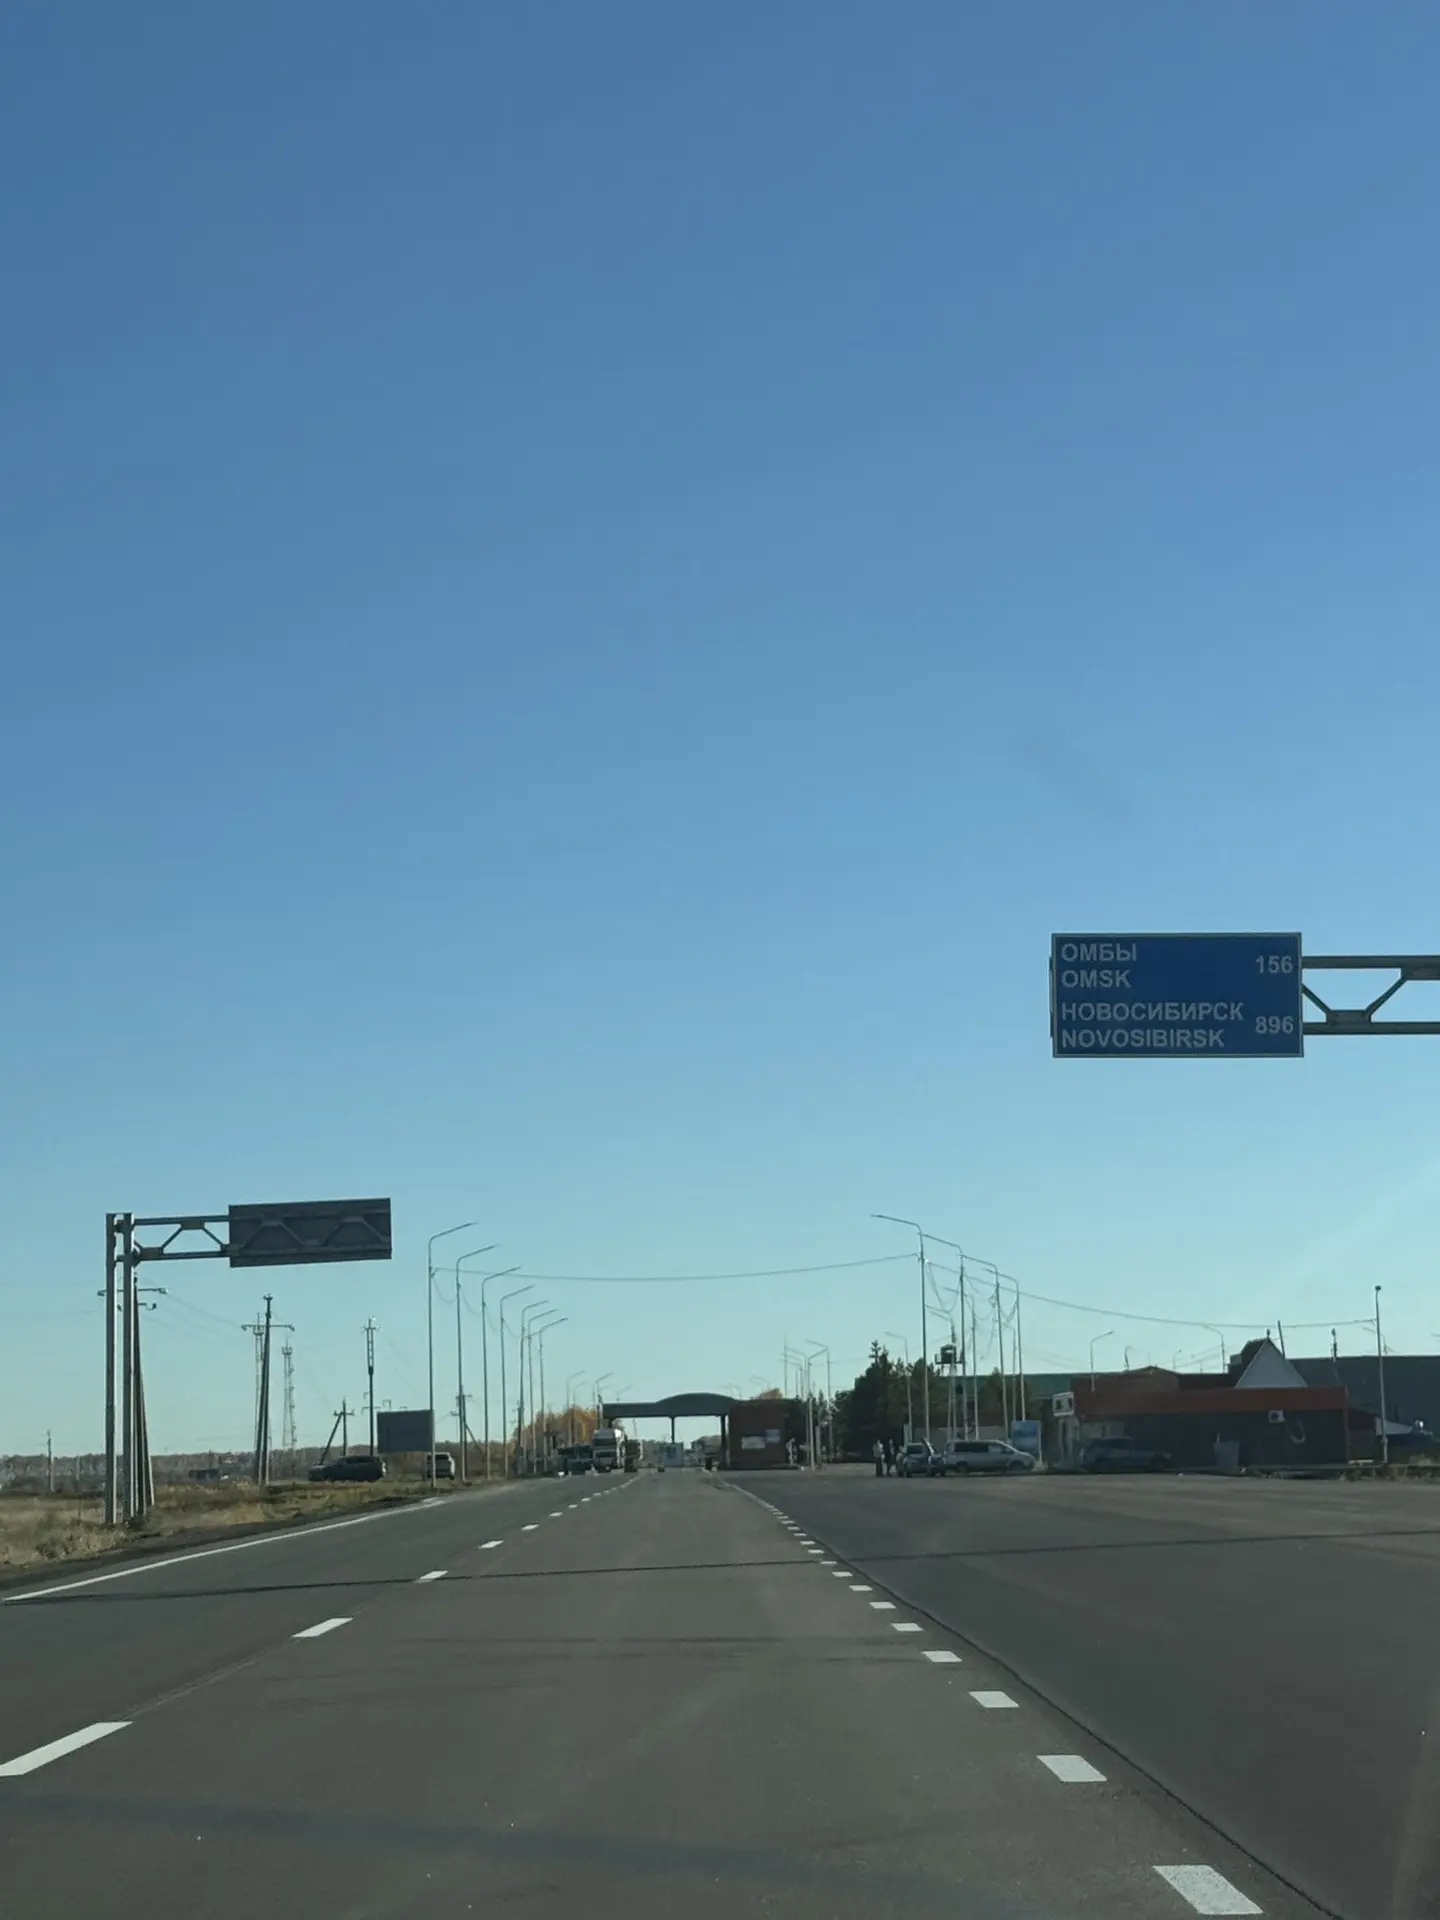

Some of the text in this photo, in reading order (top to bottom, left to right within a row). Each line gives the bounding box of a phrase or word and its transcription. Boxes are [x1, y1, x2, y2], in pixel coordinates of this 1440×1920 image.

[1061, 943, 1137, 962] ОМБЫ
[1255, 955, 1294, 974] 156
[1061, 969, 1132, 988] OMSK
[1061, 1002, 1244, 1021] НОВОСИБИРСК
[1255, 1016, 1294, 1034] 896
[1061, 1029, 1225, 1048] NOVOSIBIRSK
